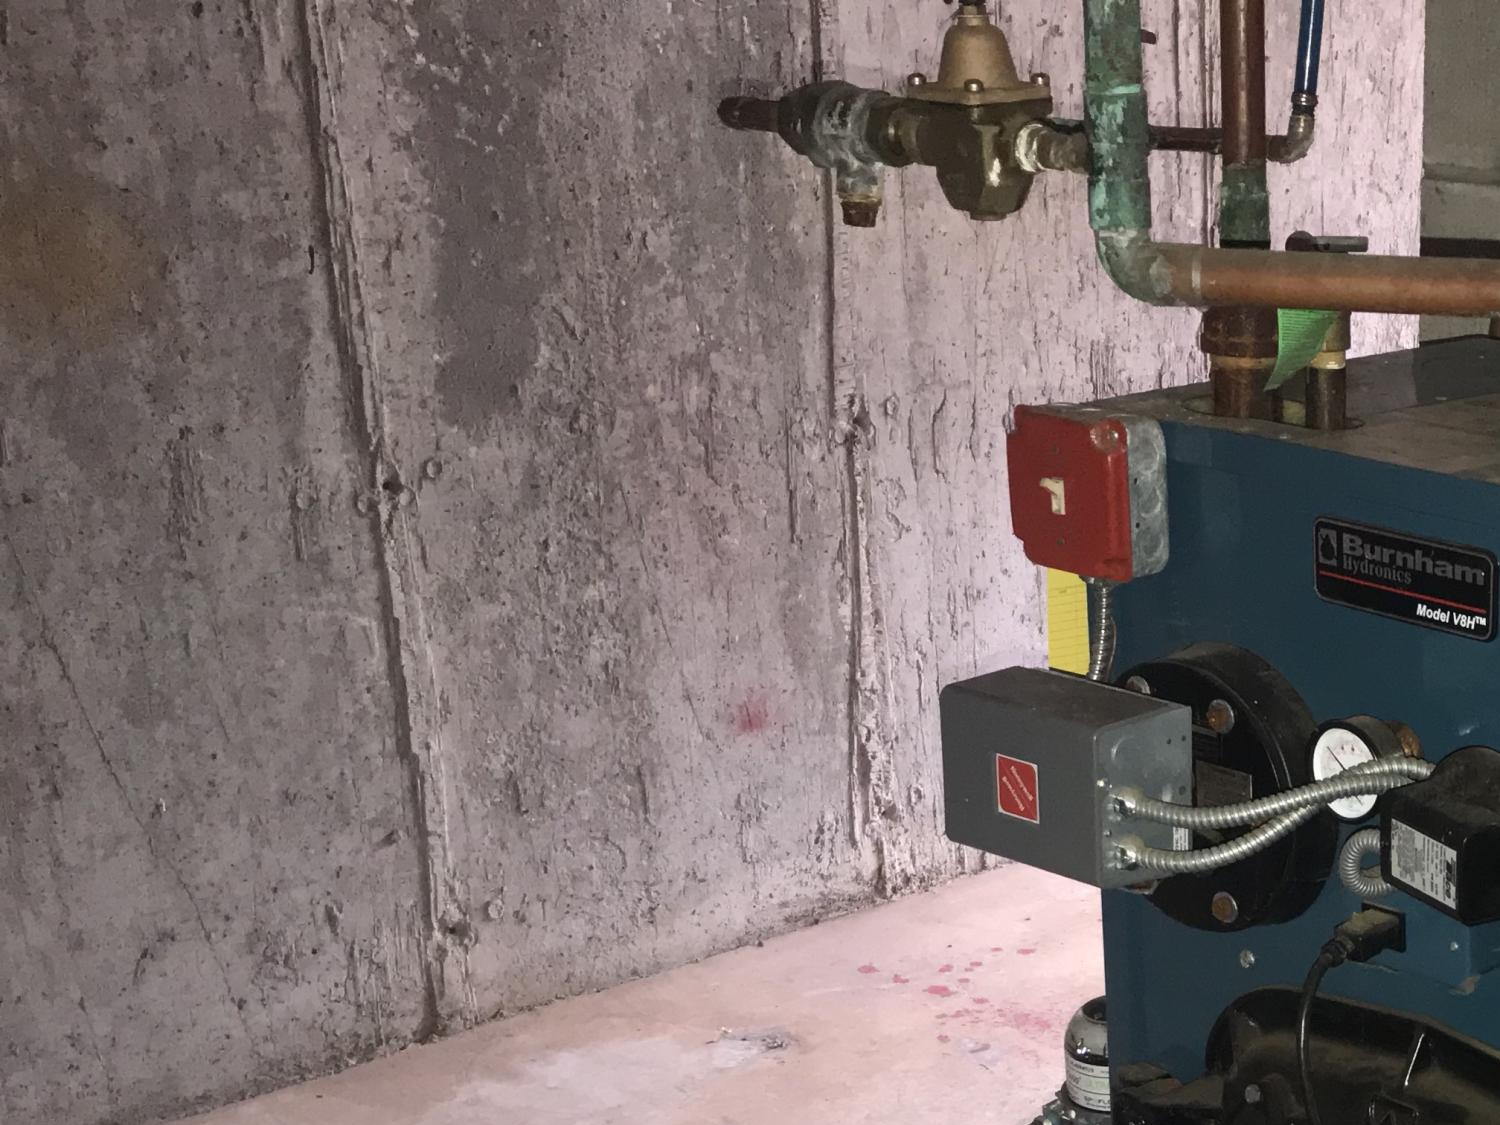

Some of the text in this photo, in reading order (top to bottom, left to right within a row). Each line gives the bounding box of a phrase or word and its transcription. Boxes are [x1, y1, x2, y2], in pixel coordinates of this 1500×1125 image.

[1342, 532, 1485, 586] Burnham
[1342, 555, 1413, 585] Hydronics
[1416, 603, 1450, 624] Model
